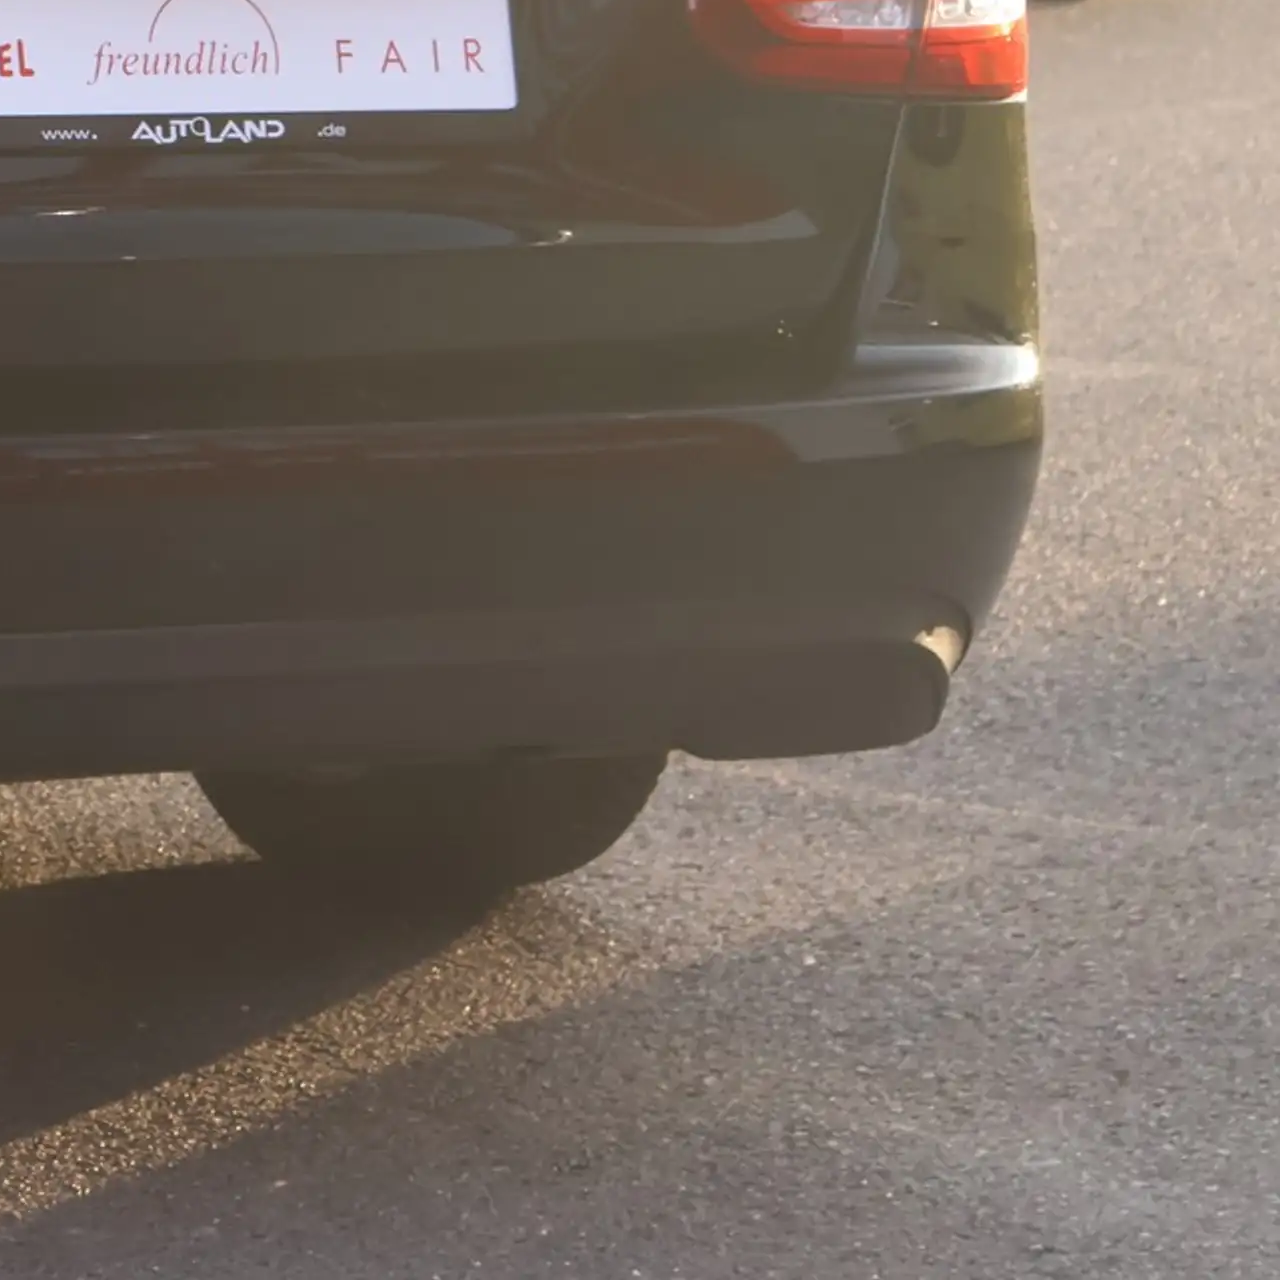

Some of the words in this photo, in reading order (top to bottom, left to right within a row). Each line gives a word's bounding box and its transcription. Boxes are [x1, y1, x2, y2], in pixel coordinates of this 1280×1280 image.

[85, 39, 269, 86] freundlich
[335, 37, 485, 74] FAIR
[41, 128, 99, 141] www.
[131, 116, 286, 145] AUTOLAND
